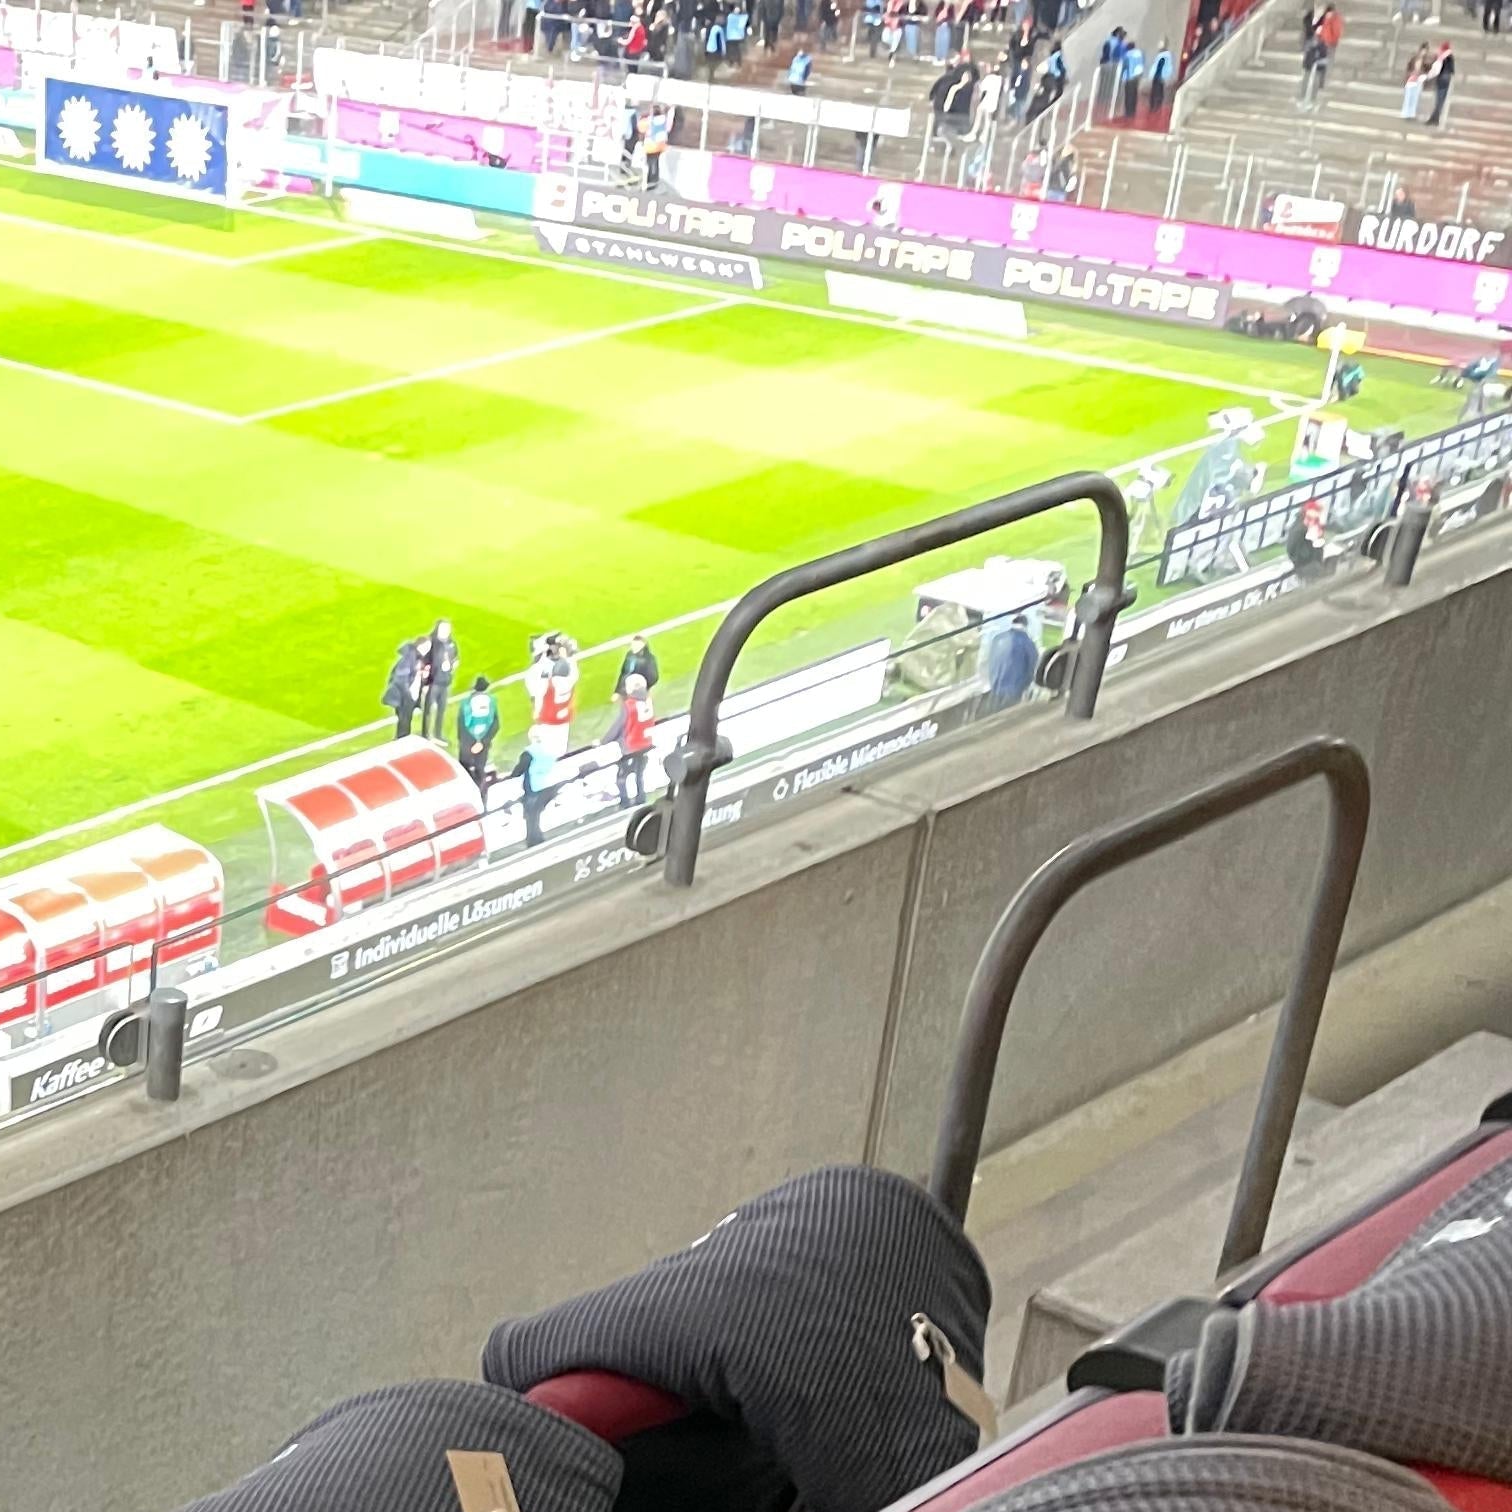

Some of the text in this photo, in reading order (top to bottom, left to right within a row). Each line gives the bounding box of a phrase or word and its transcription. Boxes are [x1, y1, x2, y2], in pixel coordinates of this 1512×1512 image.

[354, 879, 544, 970] Individuelle Lösungen
[29, 1056, 106, 1102] Kaffee
